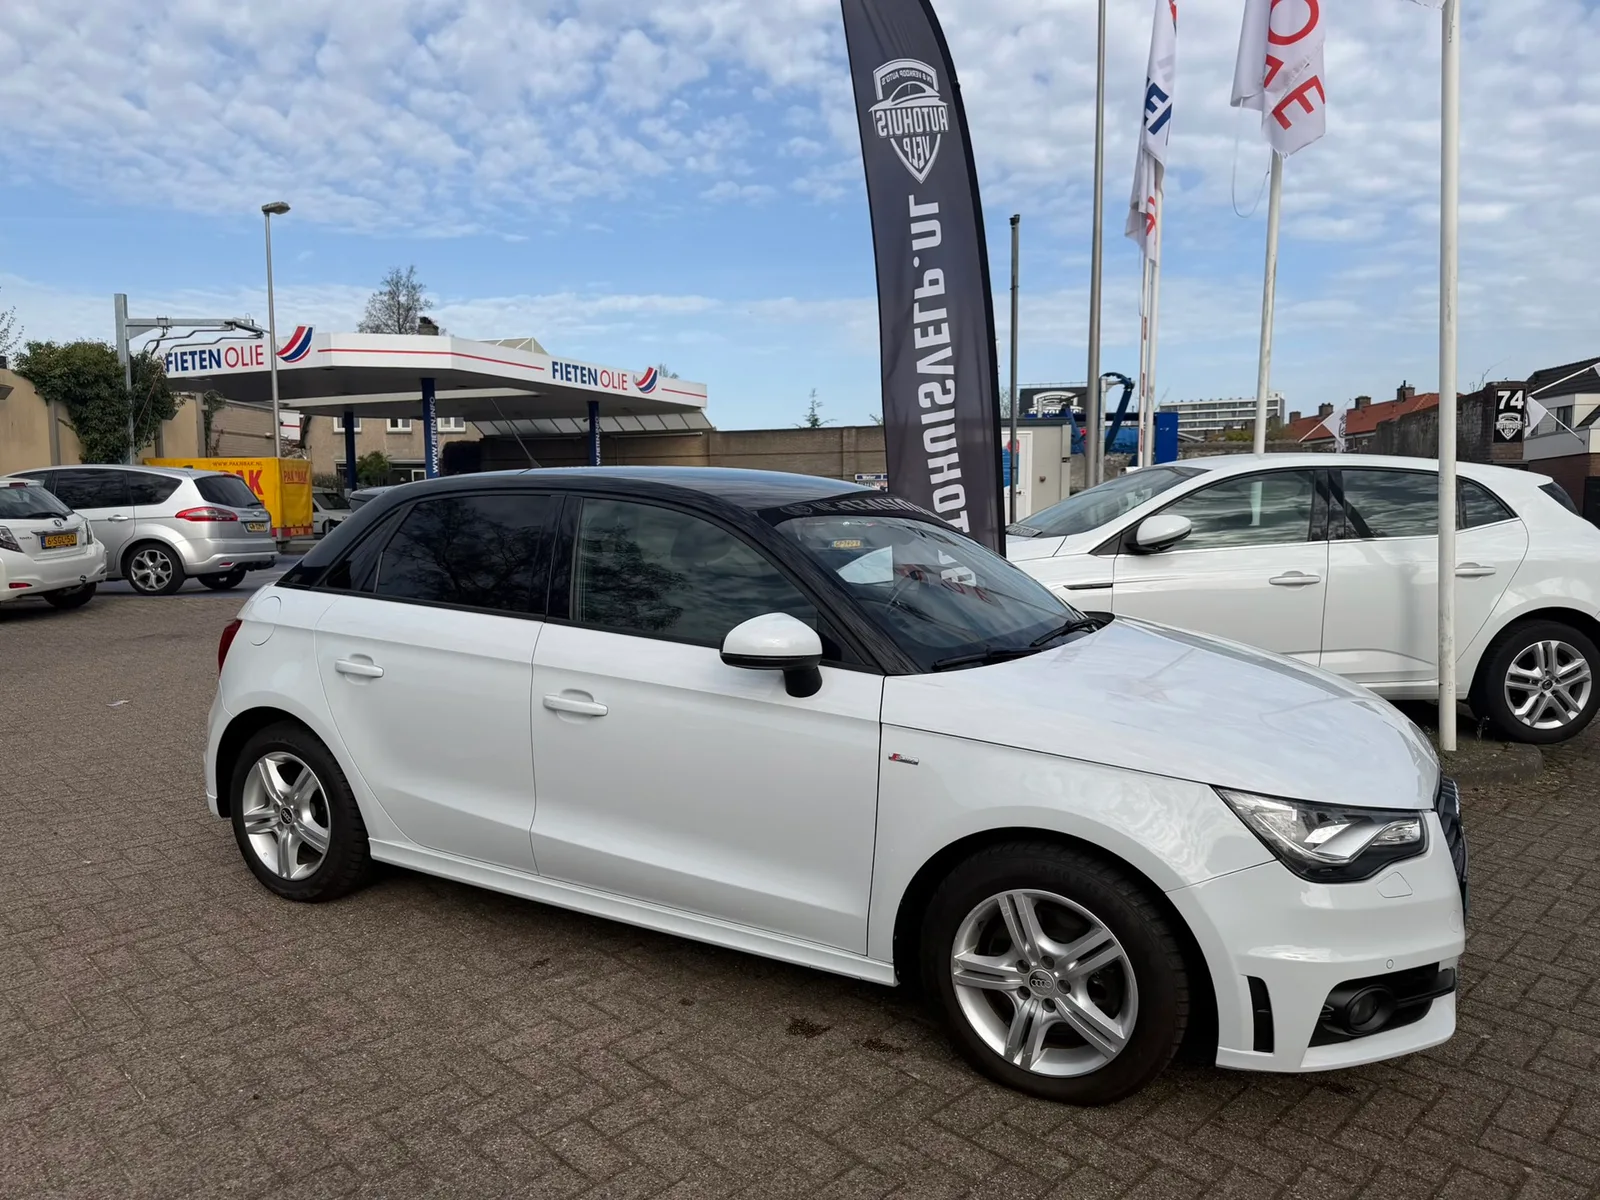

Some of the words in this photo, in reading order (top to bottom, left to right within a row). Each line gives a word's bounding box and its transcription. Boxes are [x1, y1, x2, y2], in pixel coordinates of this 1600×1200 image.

[166, 347, 222, 373] FIETEN
[225, 344, 265, 368] OLIE
[551, 361, 598, 387] FIETEN
[600, 369, 628, 391] OLIE
[1497, 390, 1524, 410] 74
[429, 396, 439, 474] WWW.FIETEN.INFO
